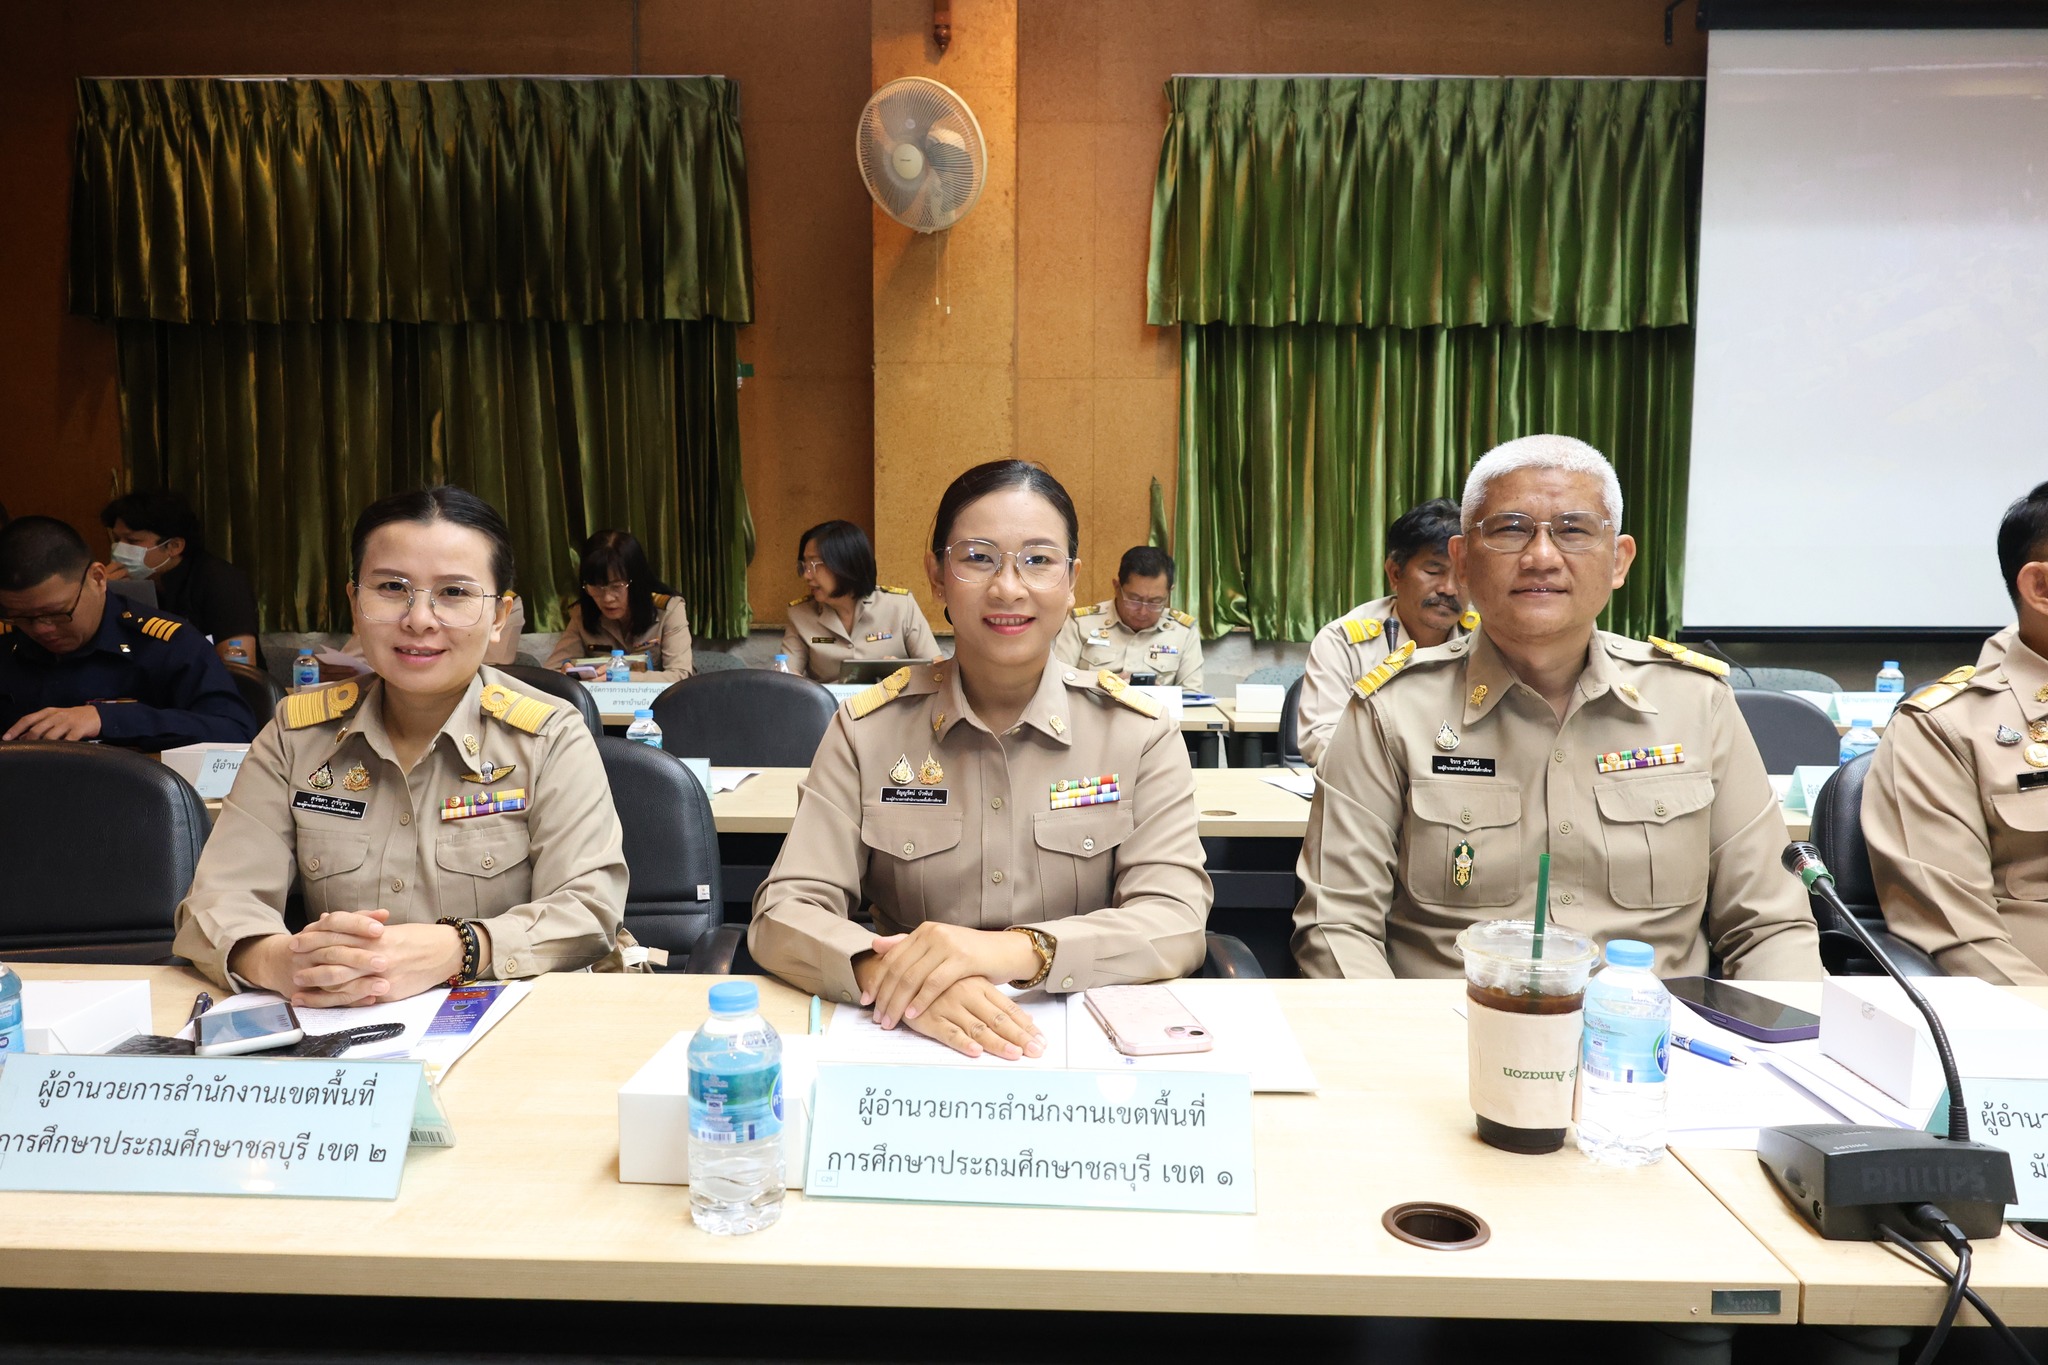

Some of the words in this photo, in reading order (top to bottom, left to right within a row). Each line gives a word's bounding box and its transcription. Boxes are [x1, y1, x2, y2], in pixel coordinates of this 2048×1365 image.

[212, 758, 242, 773] ผู้อำน
[38, 1069, 378, 1108] ผู้อำนวยการสำนักงานเขตพื้นที่
[1503, 1066, 1565, 1082] Amazon
[859, 1089, 1206, 1127] ผู้อำนวยการสำนักงานเขตพื้นที่
[0, 1125, 311, 1171] การศึกษาประถมศึกษาชลบุรี
[317, 1143, 360, 1162] เขต
[369, 1143, 388, 1163] ๒
[828, 1144, 1150, 1190] การศึกษาประถมศึกษาชลบุรี
[1159, 1163, 1206, 1184] เขต
[1217, 1169, 1235, 1187] ๑
[1861, 1165, 1986, 1194] PHILIPS
[2030, 1153, 2048, 1179] มั
